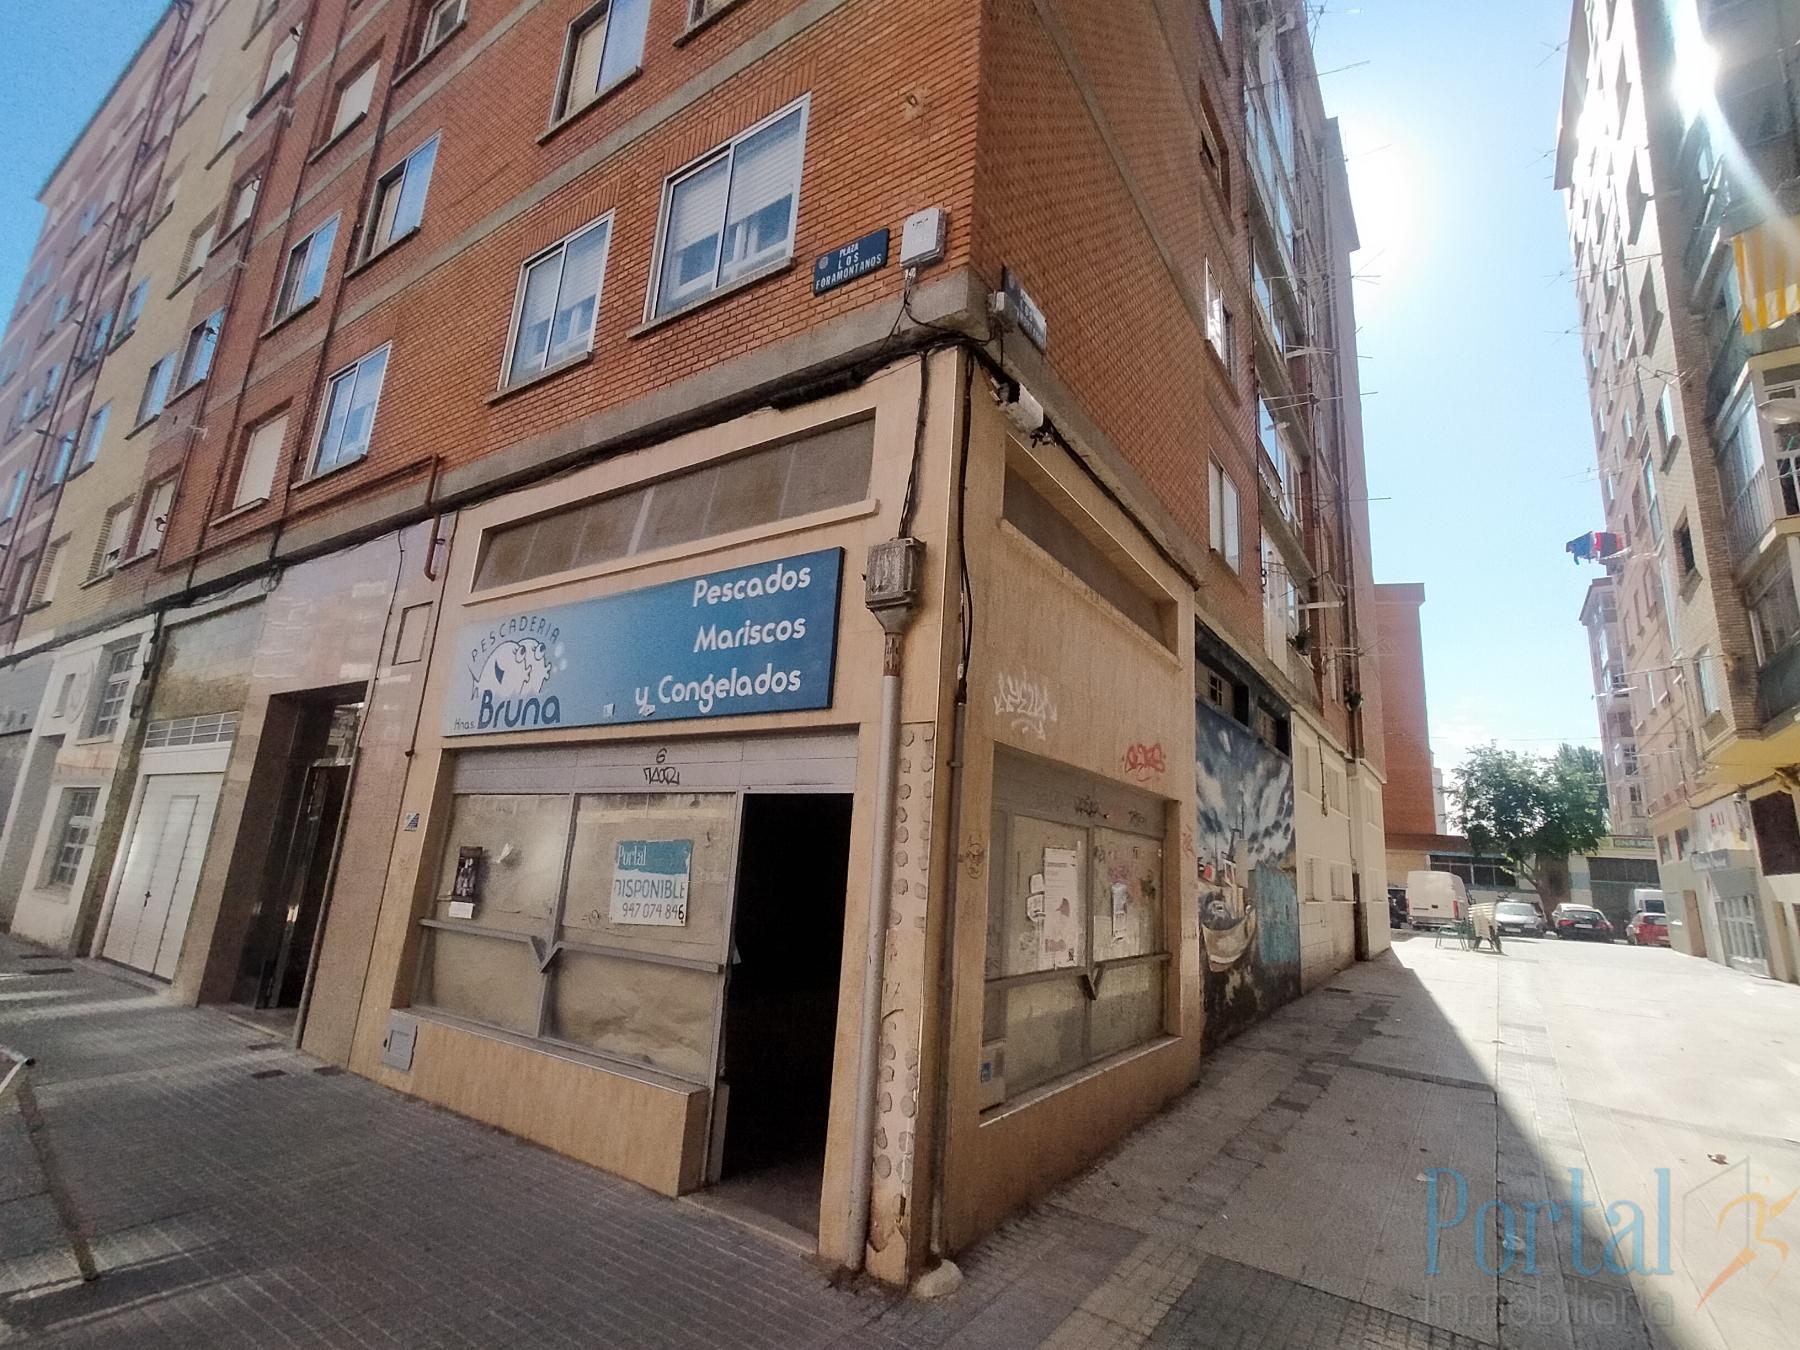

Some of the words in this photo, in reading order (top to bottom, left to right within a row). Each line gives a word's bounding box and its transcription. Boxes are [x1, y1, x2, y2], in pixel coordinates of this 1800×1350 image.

[838, 252, 859, 270] LOS
[839, 243, 859, 258] PLAZA
[815, 253, 882, 291] FORAMONTANOS
[692, 563, 811, 607] Pescados
[471, 616, 560, 662] PESCADERIA
[693, 618, 806, 653] Mariscos
[635, 686, 650, 715] y
[658, 663, 801, 713] Congelados
[477, 689, 560, 729] Bruna
[617, 845, 647, 866] Portal
[614, 879, 685, 899] DISPONIBLE
[622, 902, 641, 917] 947
[642, 903, 662, 919] 074
[664, 903, 685, 920] 846
